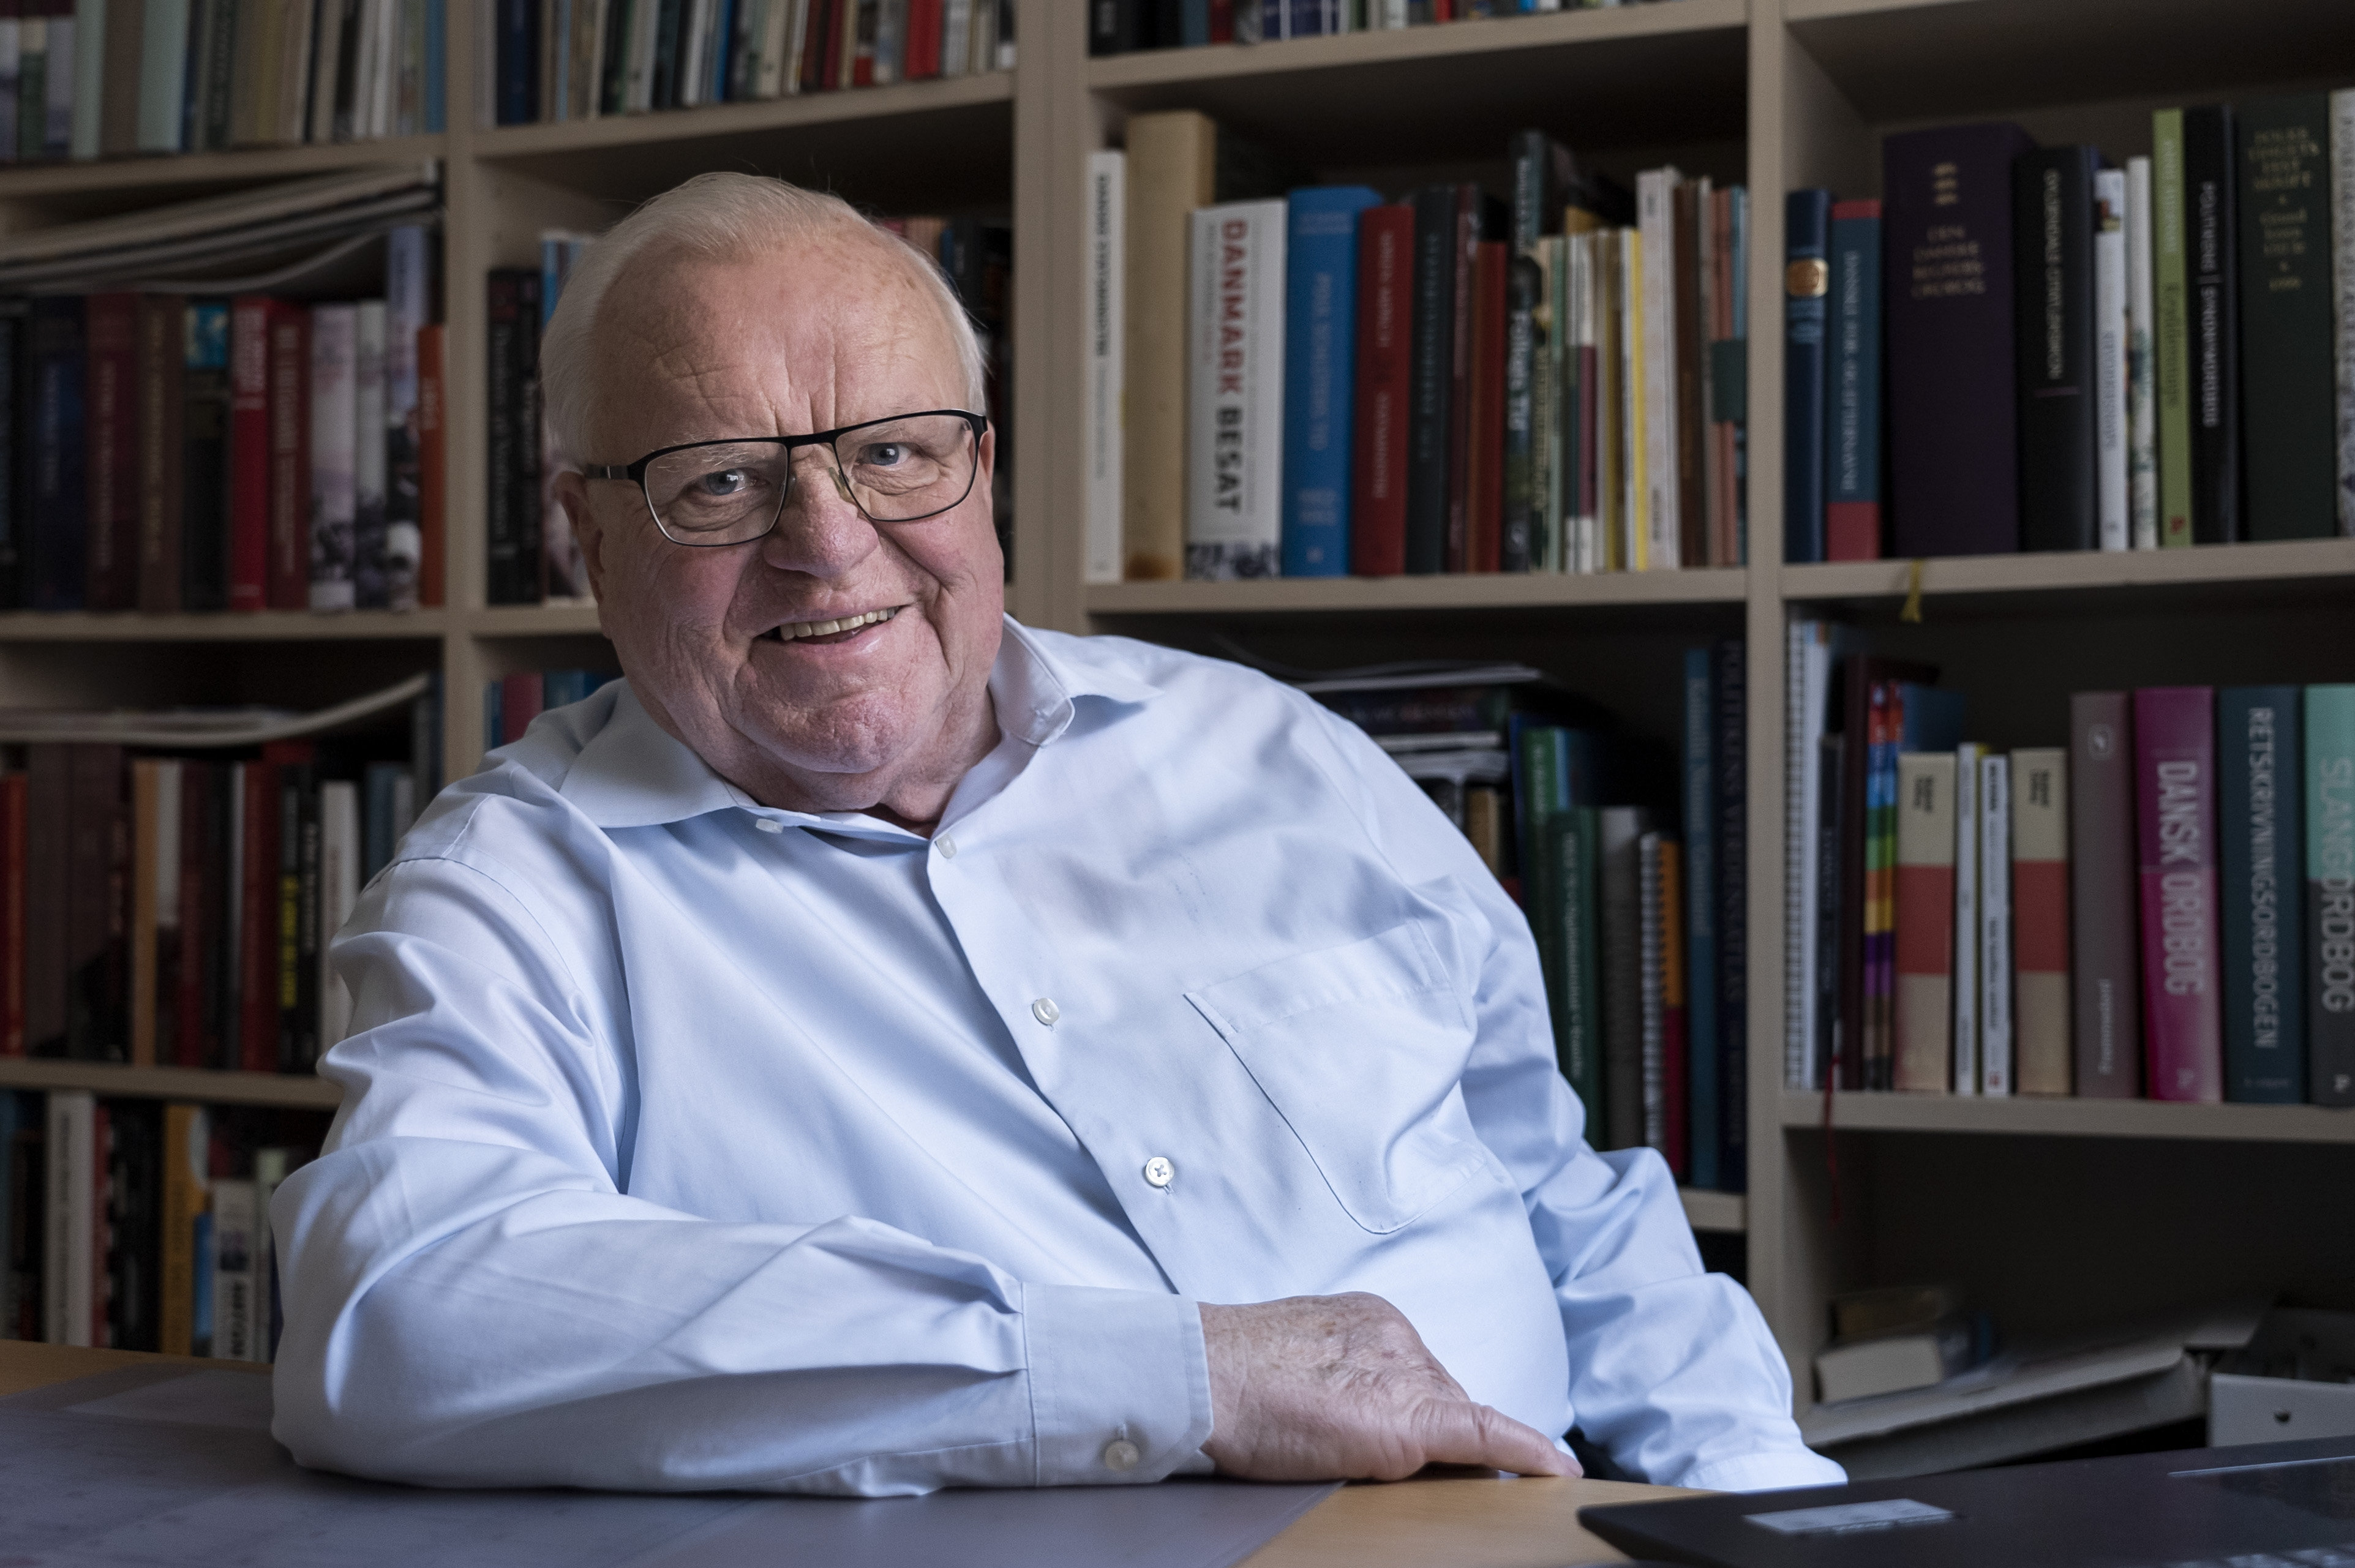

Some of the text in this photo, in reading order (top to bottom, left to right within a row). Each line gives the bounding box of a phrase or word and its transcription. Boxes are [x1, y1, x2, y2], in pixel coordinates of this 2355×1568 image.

[1214, 219, 1247, 513] DANMARK BESAT
[2199, 182, 2218, 426] POLITIKENS SYNONYMORDBOG
[1721, 639, 1745, 797] POLITIKENS
[1722, 803, 1745, 1004] VERDENSATLAS
[2157, 760, 2206, 997] DANSK ORDBOG
[2247, 705, 2280, 1049] RETSKRIVNINGSORDBOGEN
[2318, 756, 2355, 1015] SLANGORDBOG
